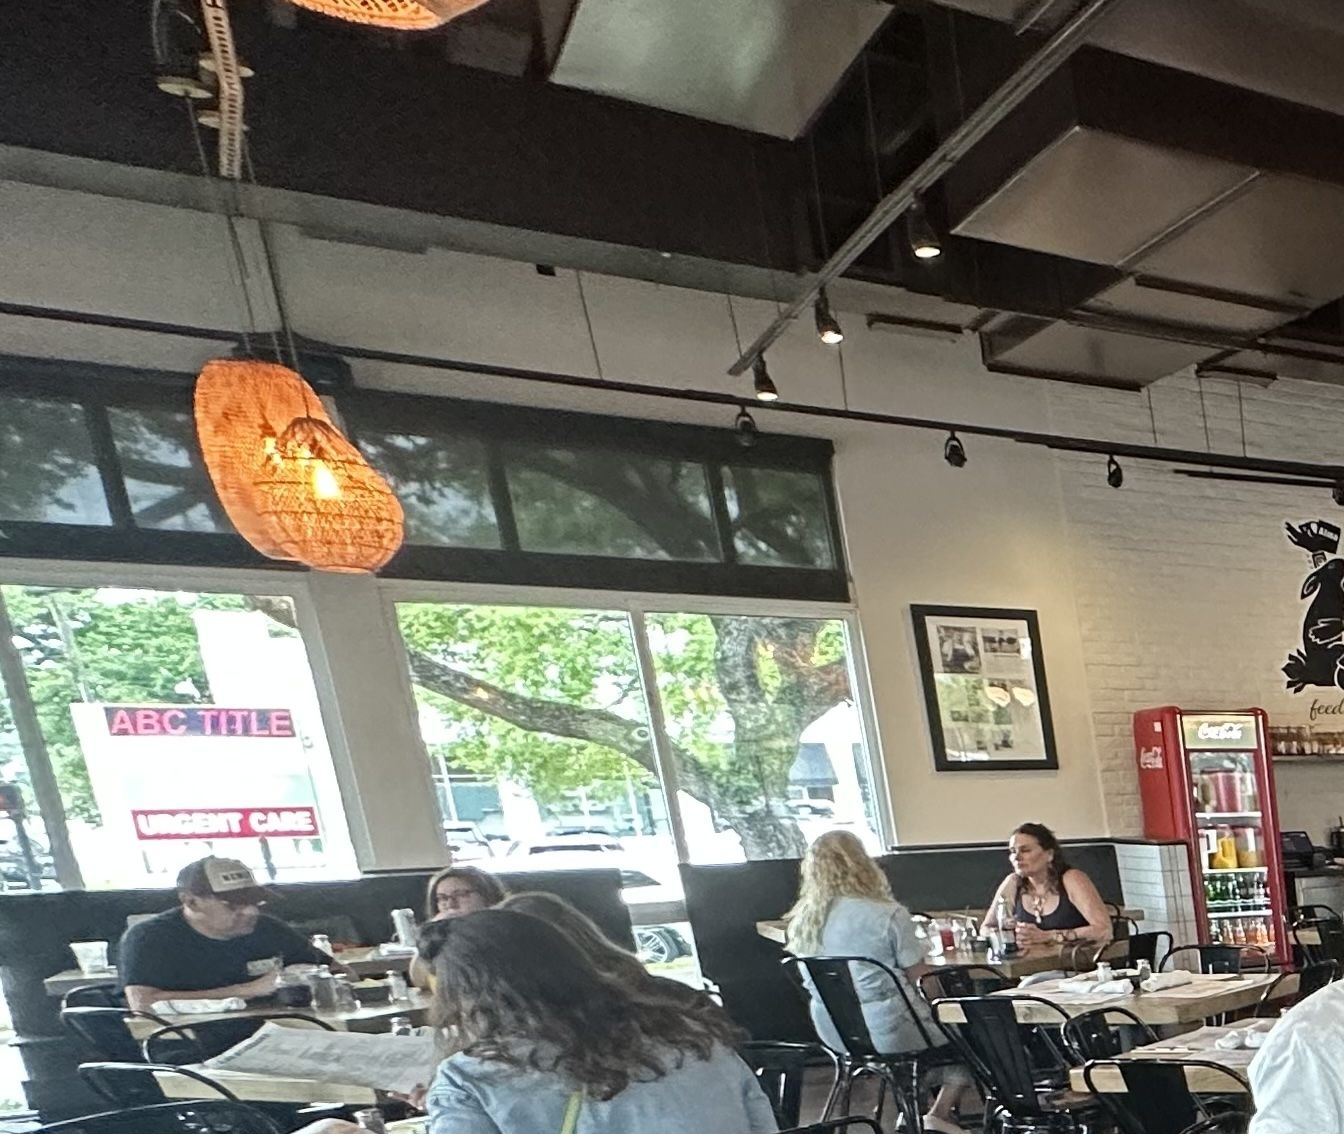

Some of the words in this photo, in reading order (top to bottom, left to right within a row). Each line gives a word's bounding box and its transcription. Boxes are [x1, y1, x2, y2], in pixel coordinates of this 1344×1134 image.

[1318, 526, 1339, 541] Alma
[1310, 698, 1344, 720] feed
[111, 709, 187, 735] ABC
[198, 709, 293, 736] TITLE
[137, 812, 243, 836] URGENT
[248, 811, 315, 832] CARE
